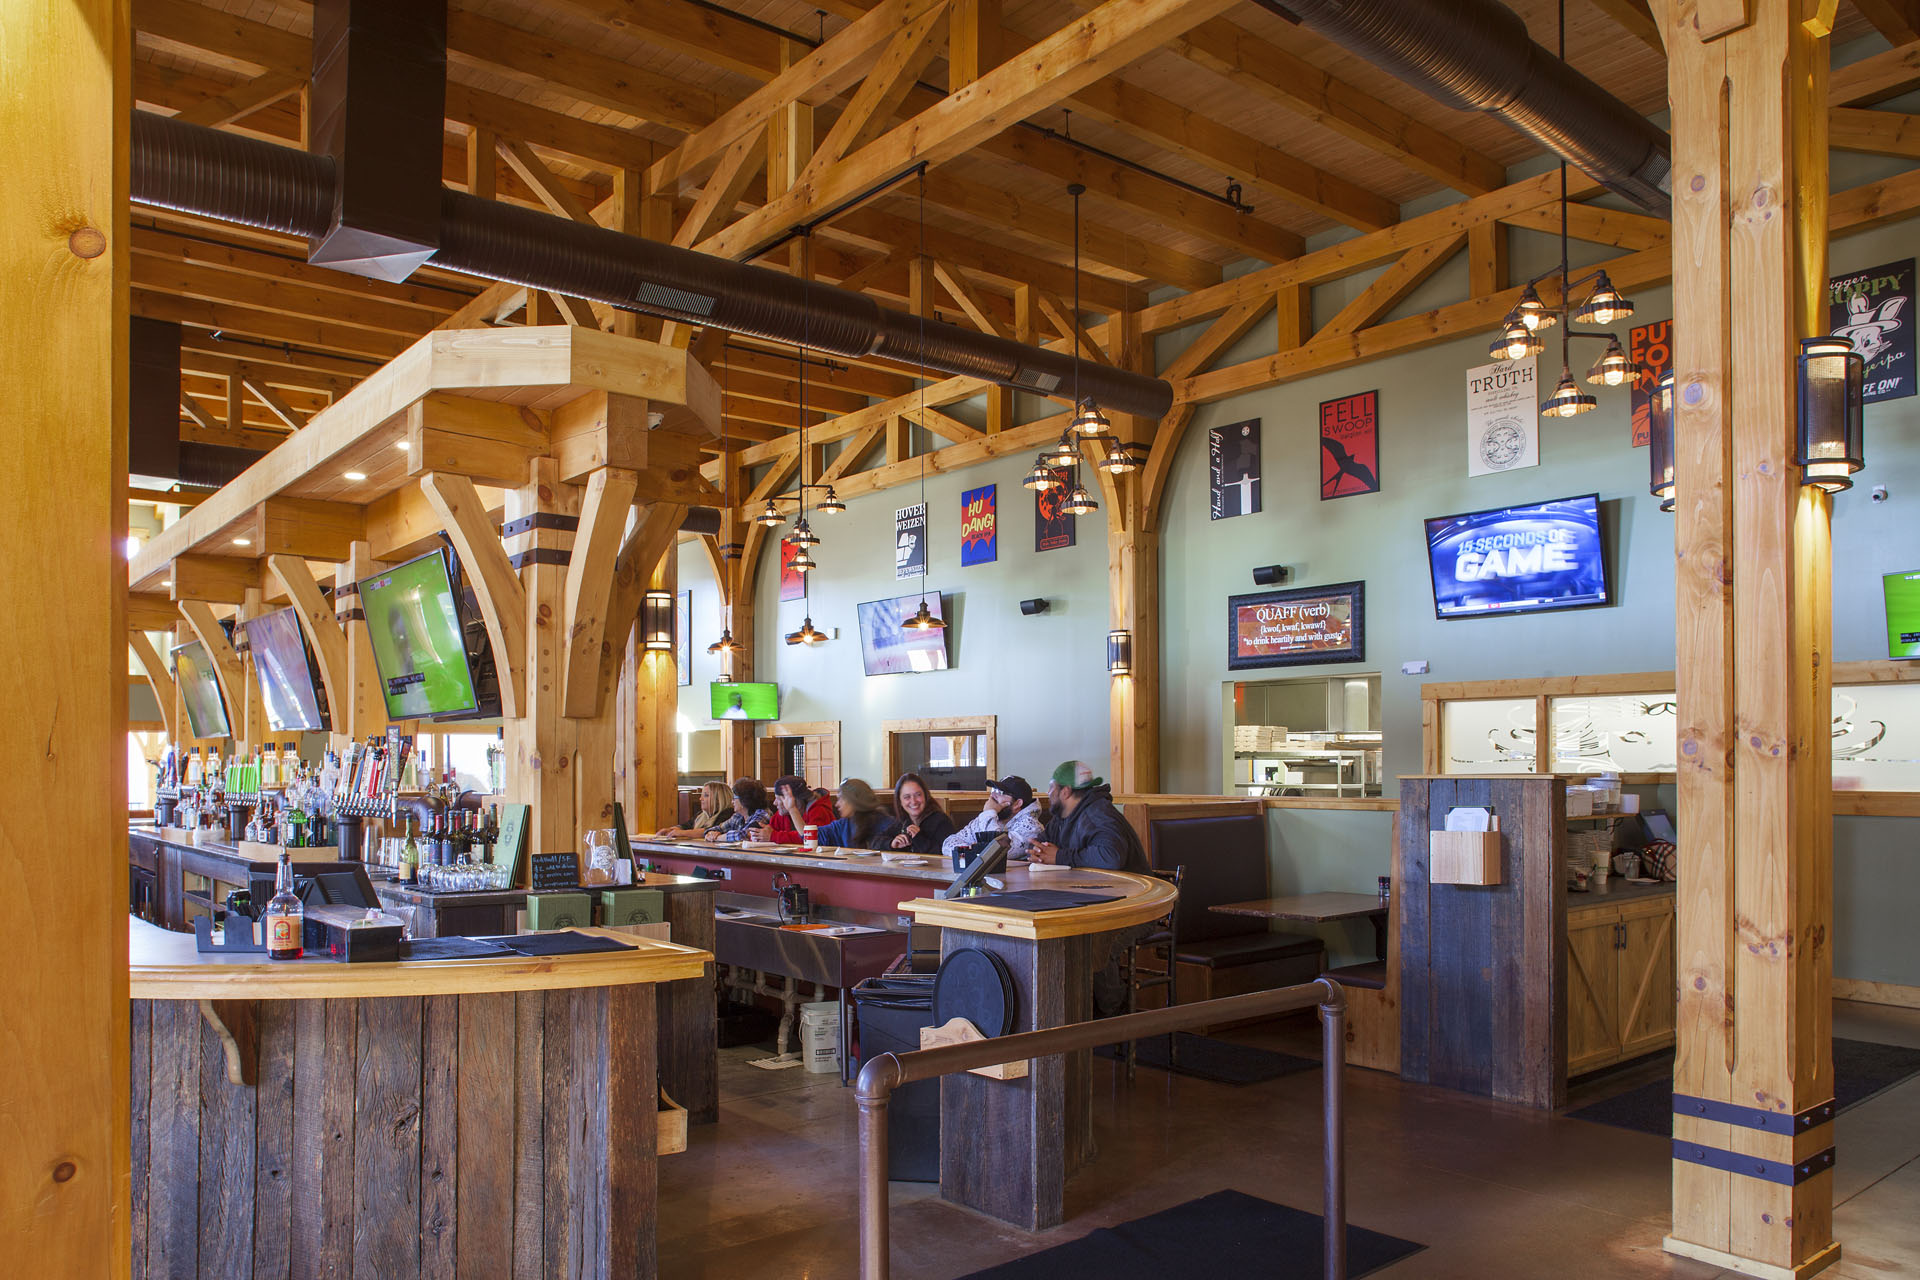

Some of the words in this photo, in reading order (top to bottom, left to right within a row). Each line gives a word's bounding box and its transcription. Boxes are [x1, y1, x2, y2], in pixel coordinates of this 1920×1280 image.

[1830, 274, 1868, 294] igger
[1489, 361, 1515, 374] Hard
[1470, 367, 1533, 394] TRUTH
[1324, 397, 1372, 426] FELL
[1324, 417, 1372, 436] SWOOP
[968, 499, 983, 517] HU
[896, 516, 925, 531] WEIZEN
[962, 513, 994, 537] DANG!
[1457, 541, 1473, 556] 15
[1475, 531, 1545, 553] SECONDS
[1455, 542, 1579, 582] GAME
[1256, 606, 1297, 623] QUAFF
[1299, 602, 1330, 620] (verb)
[1253, 635, 1269, 645] drink
[1270, 634, 1294, 644] heartily
[1295, 632, 1307, 641] and
[1307, 630, 1323, 641] with
[1324, 630, 1345, 642] gusto"
